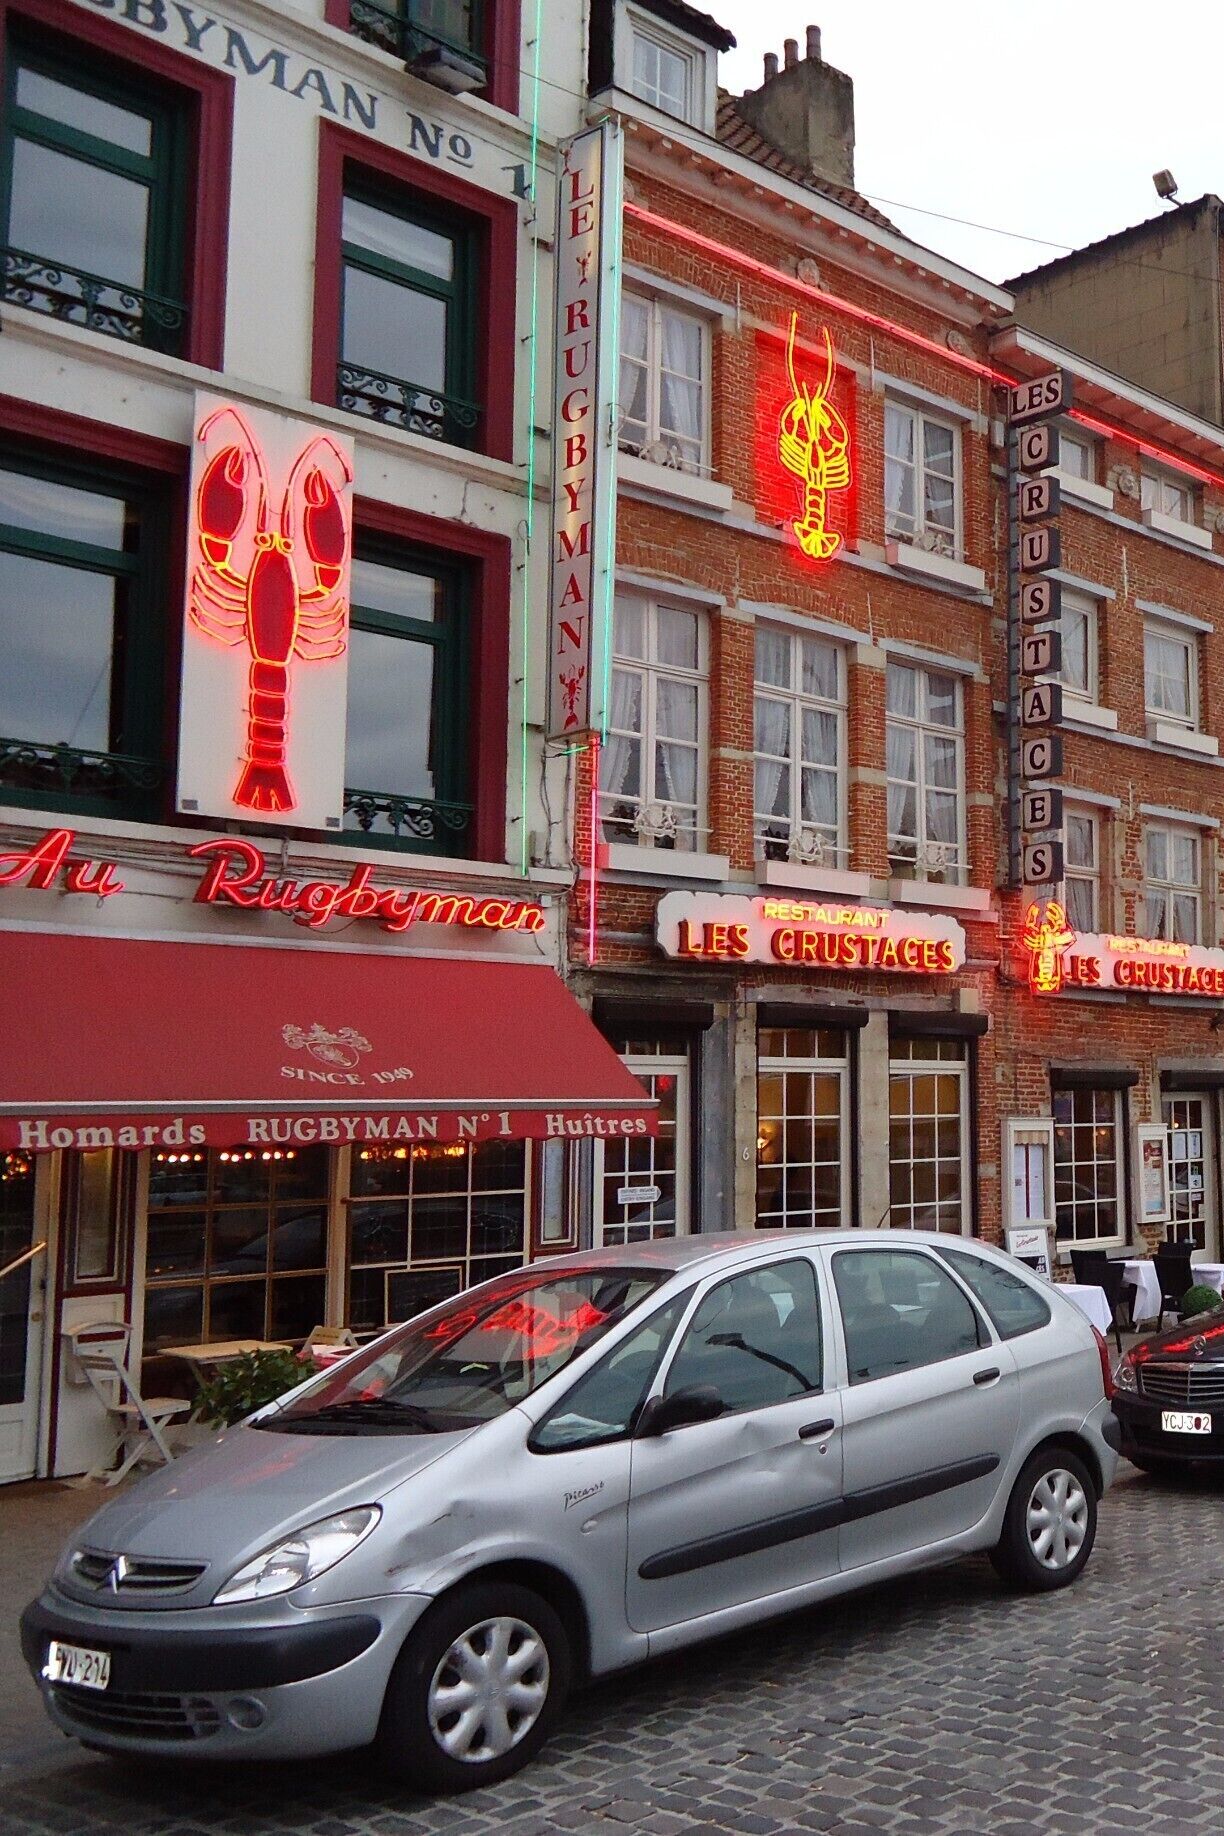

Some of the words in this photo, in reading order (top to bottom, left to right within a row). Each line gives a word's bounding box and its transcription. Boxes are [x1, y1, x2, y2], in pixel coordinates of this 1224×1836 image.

[88, 0, 378, 129] BYMAN
[501, 163, 526, 199] 1
[568, 167, 595, 240] LE
[1012, 376, 1060, 414] LES
[556, 299, 591, 655] RUGBYMAN
[1026, 431, 1047, 877] CRUSTACES
[0, 827, 126, 898] Au
[187, 838, 547, 933] Rugbyman
[763, 902, 890, 929] RESTAURANT
[678, 919, 752, 956] LES
[280, 1065, 367, 1086] SINCE
[371, 1067, 415, 1084] 1949
[18, 1117, 206, 1148] Homards
[246, 1114, 439, 1143] RUGBYMAN
[498, 1111, 513, 1135] 1
[545, 1112, 649, 1137] Huîtres
[742, 1147, 750, 1160] 6
